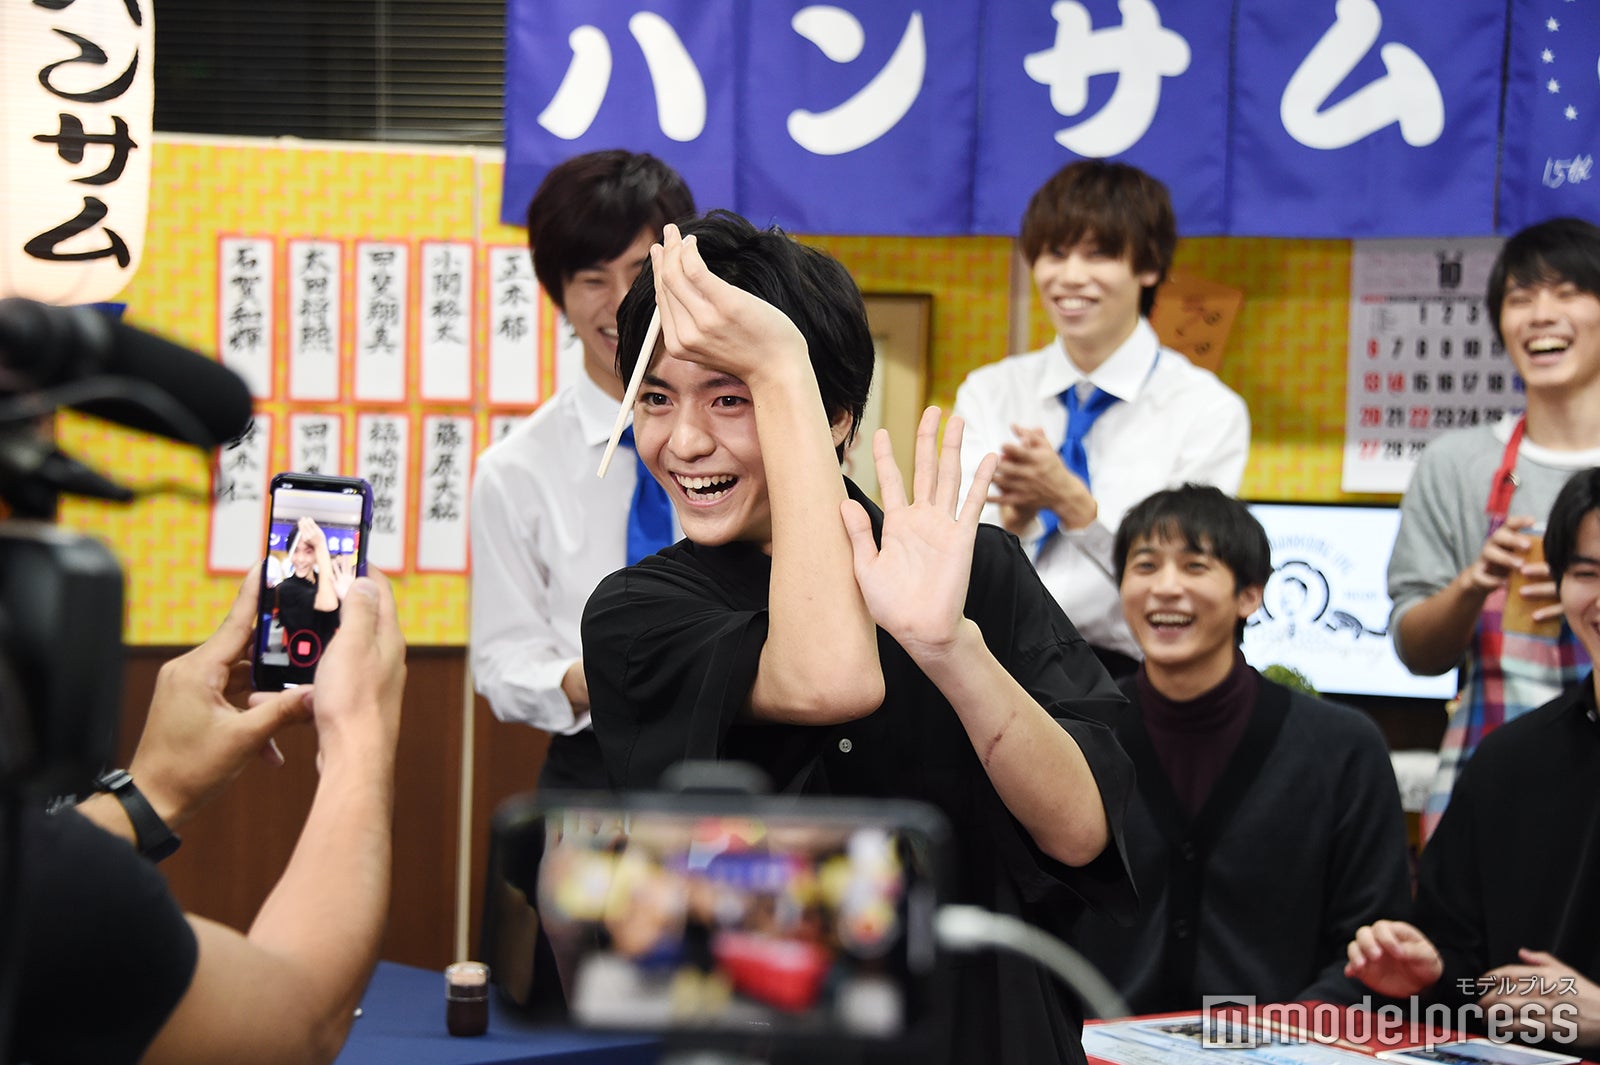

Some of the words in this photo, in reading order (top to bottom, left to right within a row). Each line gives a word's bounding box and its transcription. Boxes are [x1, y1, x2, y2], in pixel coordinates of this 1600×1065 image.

[538, 0, 1446, 158] ハンサム
[24, 0, 143, 268] ンサム
[1440, 263, 1462, 288] 10
[1419, 304, 1427, 325] 1
[1442, 304, 1453, 325] 2
[1467, 304, 1479, 325] 3
[1391, 337, 1403, 360] 7
[1416, 338, 1428, 360] 8
[1441, 338, 1452, 359] 9
[1464, 338, 1480, 359] 10
[1462, 372, 1478, 394] 17
[1487, 372, 1504, 393] 18
[1361, 407, 1382, 428] 20
[1386, 407, 1405, 428] 21
[1409, 407, 1430, 428] 22
[1433, 407, 1455, 428] 23
[1458, 407, 1479, 428] 24
[1360, 440, 1379, 460] 27
[1384, 440, 1403, 460] 28
